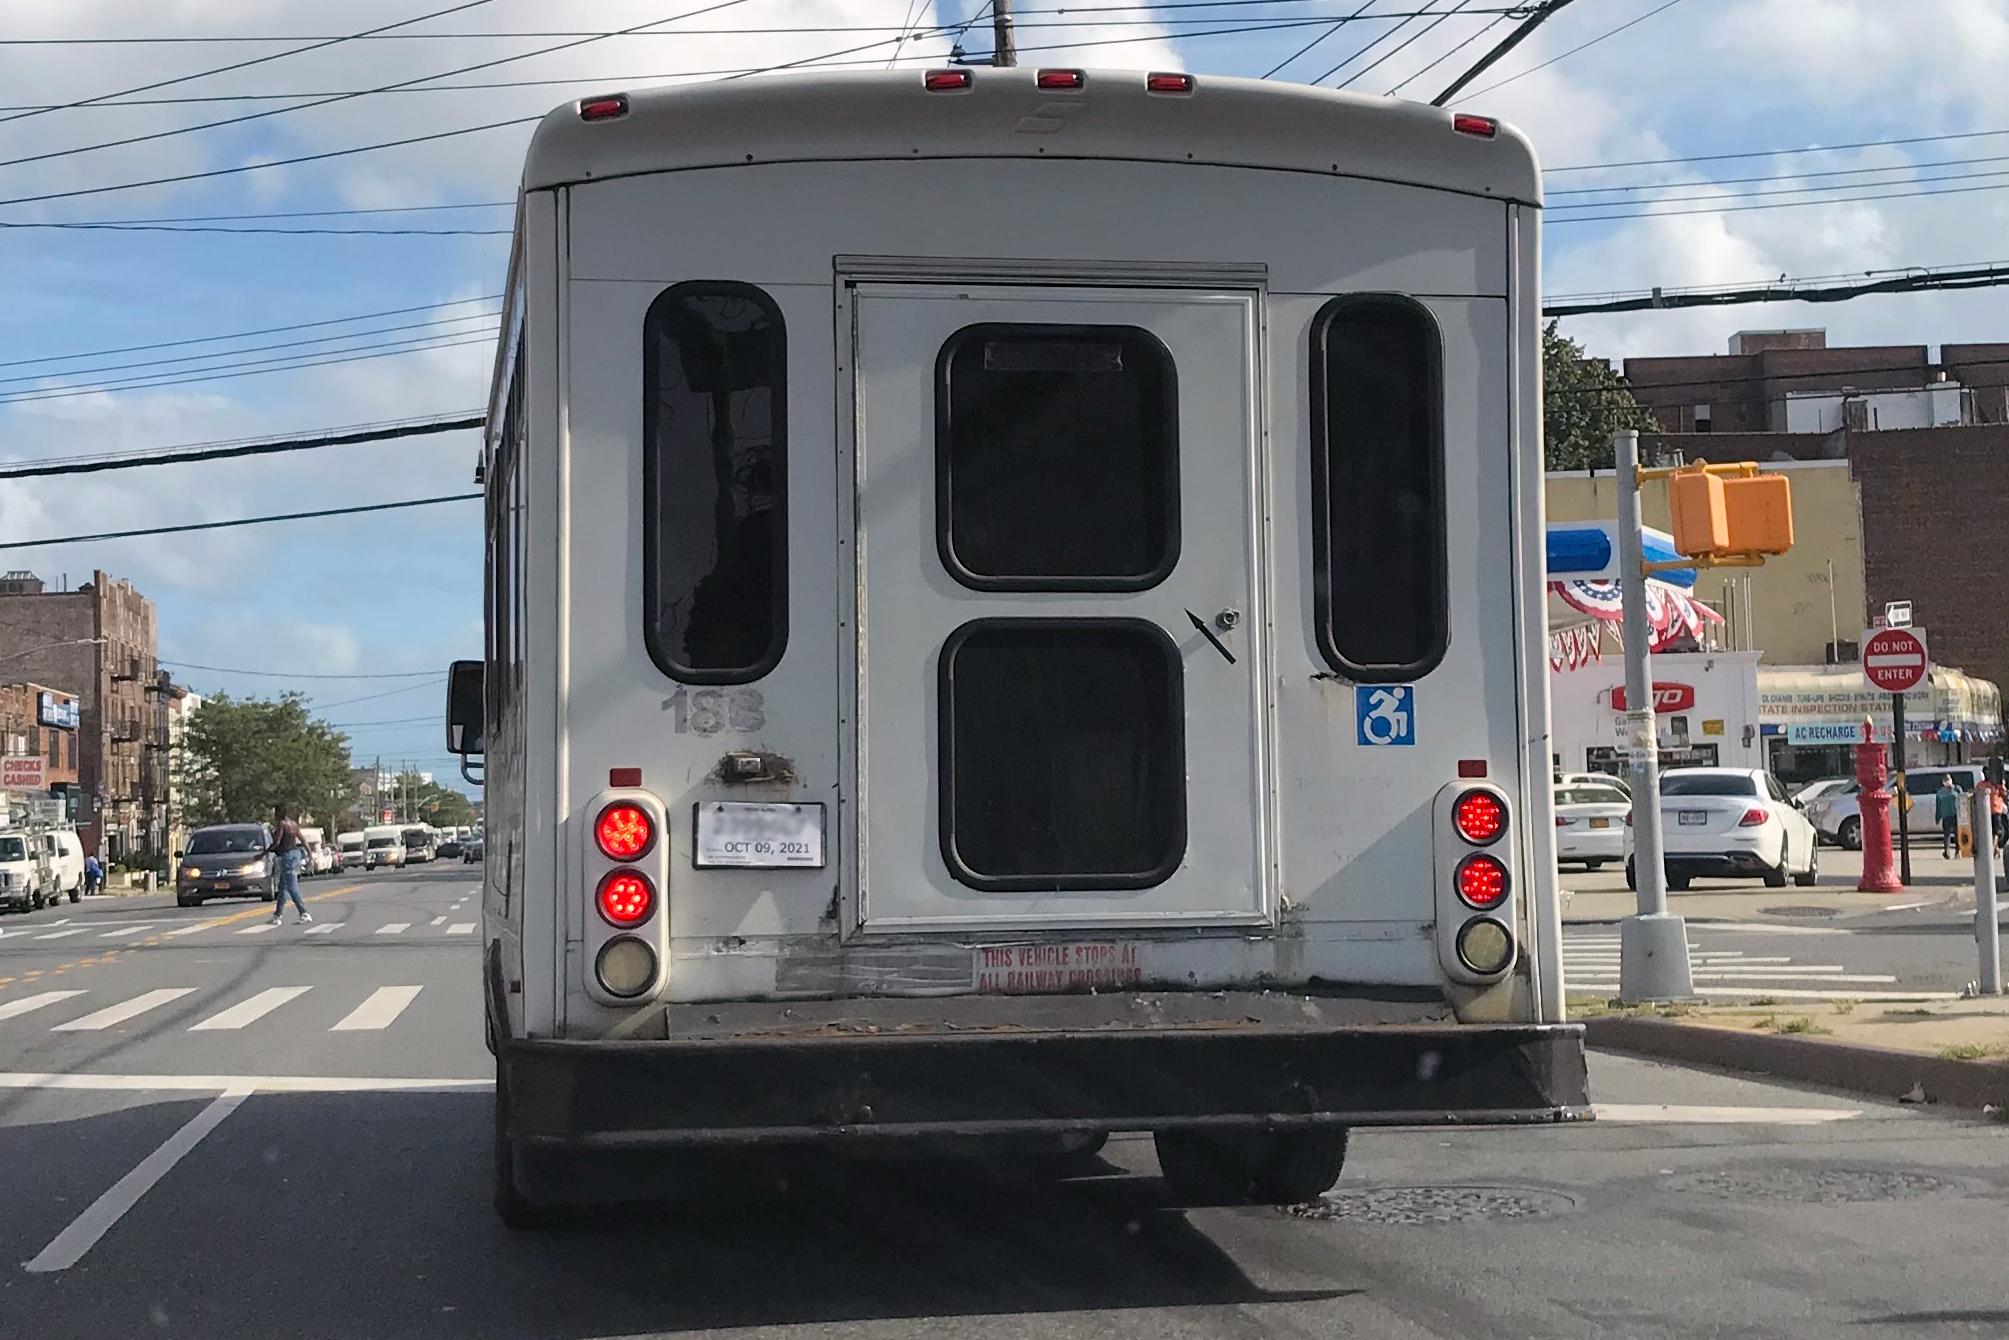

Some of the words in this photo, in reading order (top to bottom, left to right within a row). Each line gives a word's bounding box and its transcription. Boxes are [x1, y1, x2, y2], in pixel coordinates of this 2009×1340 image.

[1873, 642, 1888, 652] DO
[1892, 641, 1913, 651] NOT
[1877, 669, 1913, 680] ENTER
[1791, 702, 1857, 713] INSPECTION
[1795, 728, 1806, 740] AC
[1810, 726, 1855, 739] RECHARGE
[4, 760, 41, 772] CHECKS
[4, 774, 41, 786] CASHED
[725, 842, 751, 853] OCT
[755, 843, 775, 855] 09,
[780, 843, 810, 854] 2021
[983, 947, 1012, 967] THIS
[1019, 946, 1069, 966] VEHICLE
[1076, 944, 1115, 965] STOPS
[1122, 943, 1138, 964] AT
[980, 971, 999, 992] ALL
[1007, 969, 1064, 991] RAILWAY
